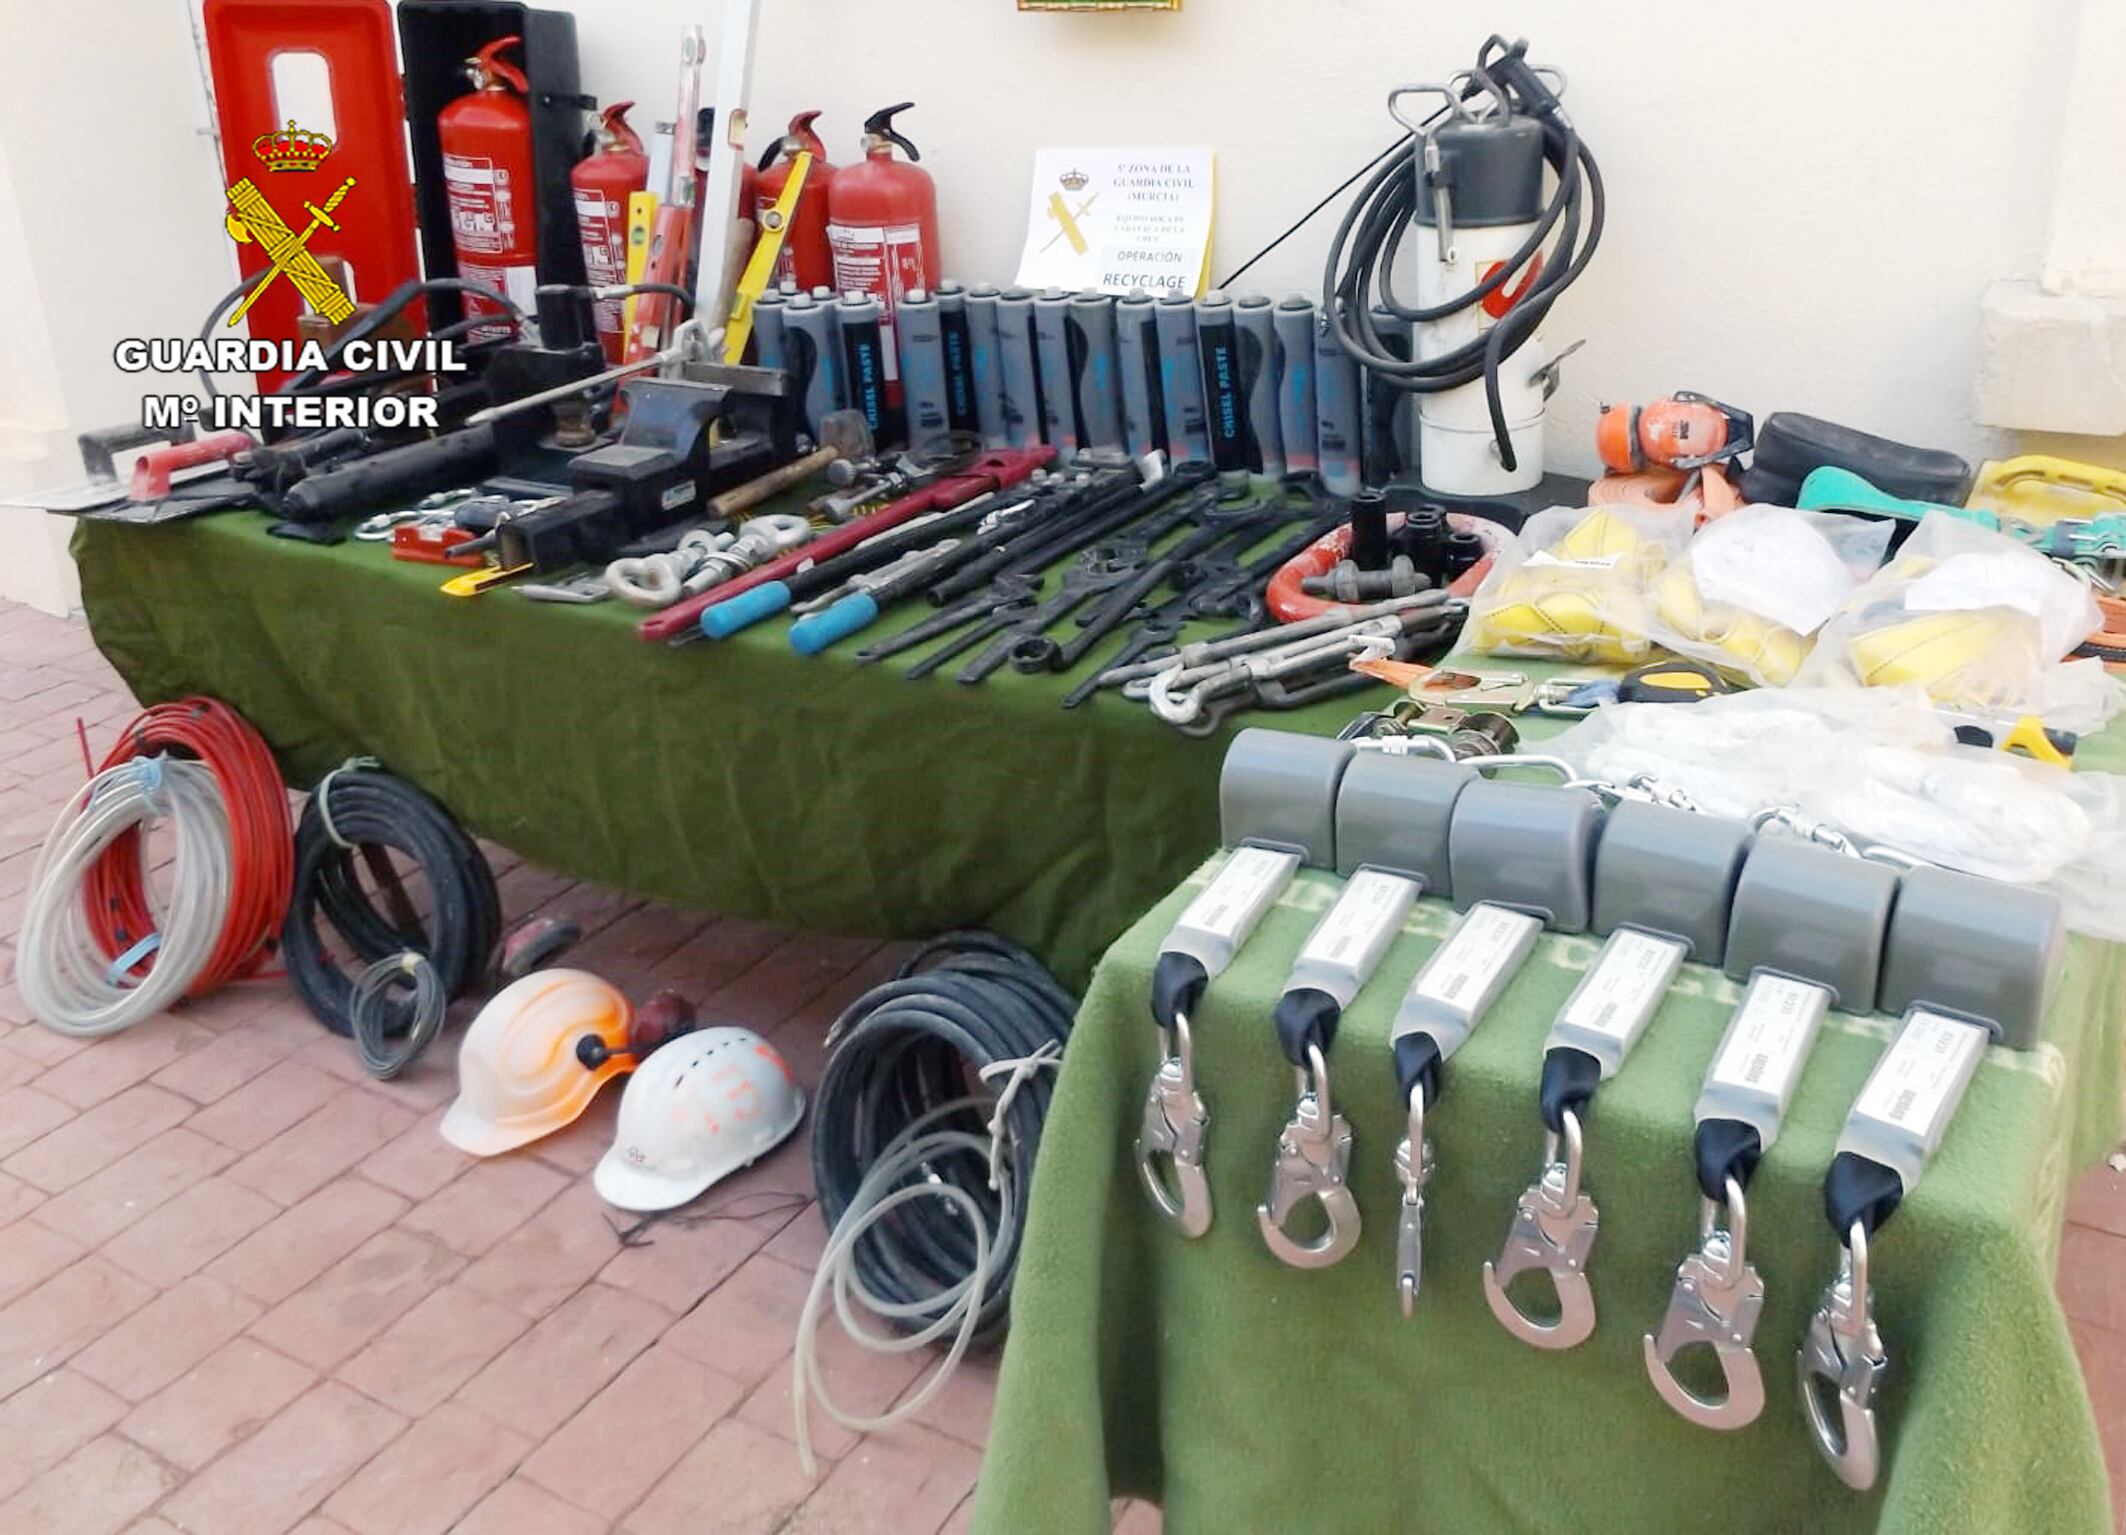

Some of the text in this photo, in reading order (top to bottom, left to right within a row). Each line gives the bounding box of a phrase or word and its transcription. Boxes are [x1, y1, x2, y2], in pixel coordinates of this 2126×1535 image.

[1128, 163, 1157, 173] ZONA
[1160, 163, 1174, 173] DE
[1177, 163, 1191, 173] LA
[1113, 178, 1194, 188] GUARDIA CIVIL
[1128, 191, 1180, 201] (MURCIA)
[1117, 250, 1183, 263] OPERACIÓN
[1103, 272, 1187, 289] RECYCLAGE
[858, 343, 874, 386] PASTE
[1215, 346, 1236, 438] CHISEL PASTE
